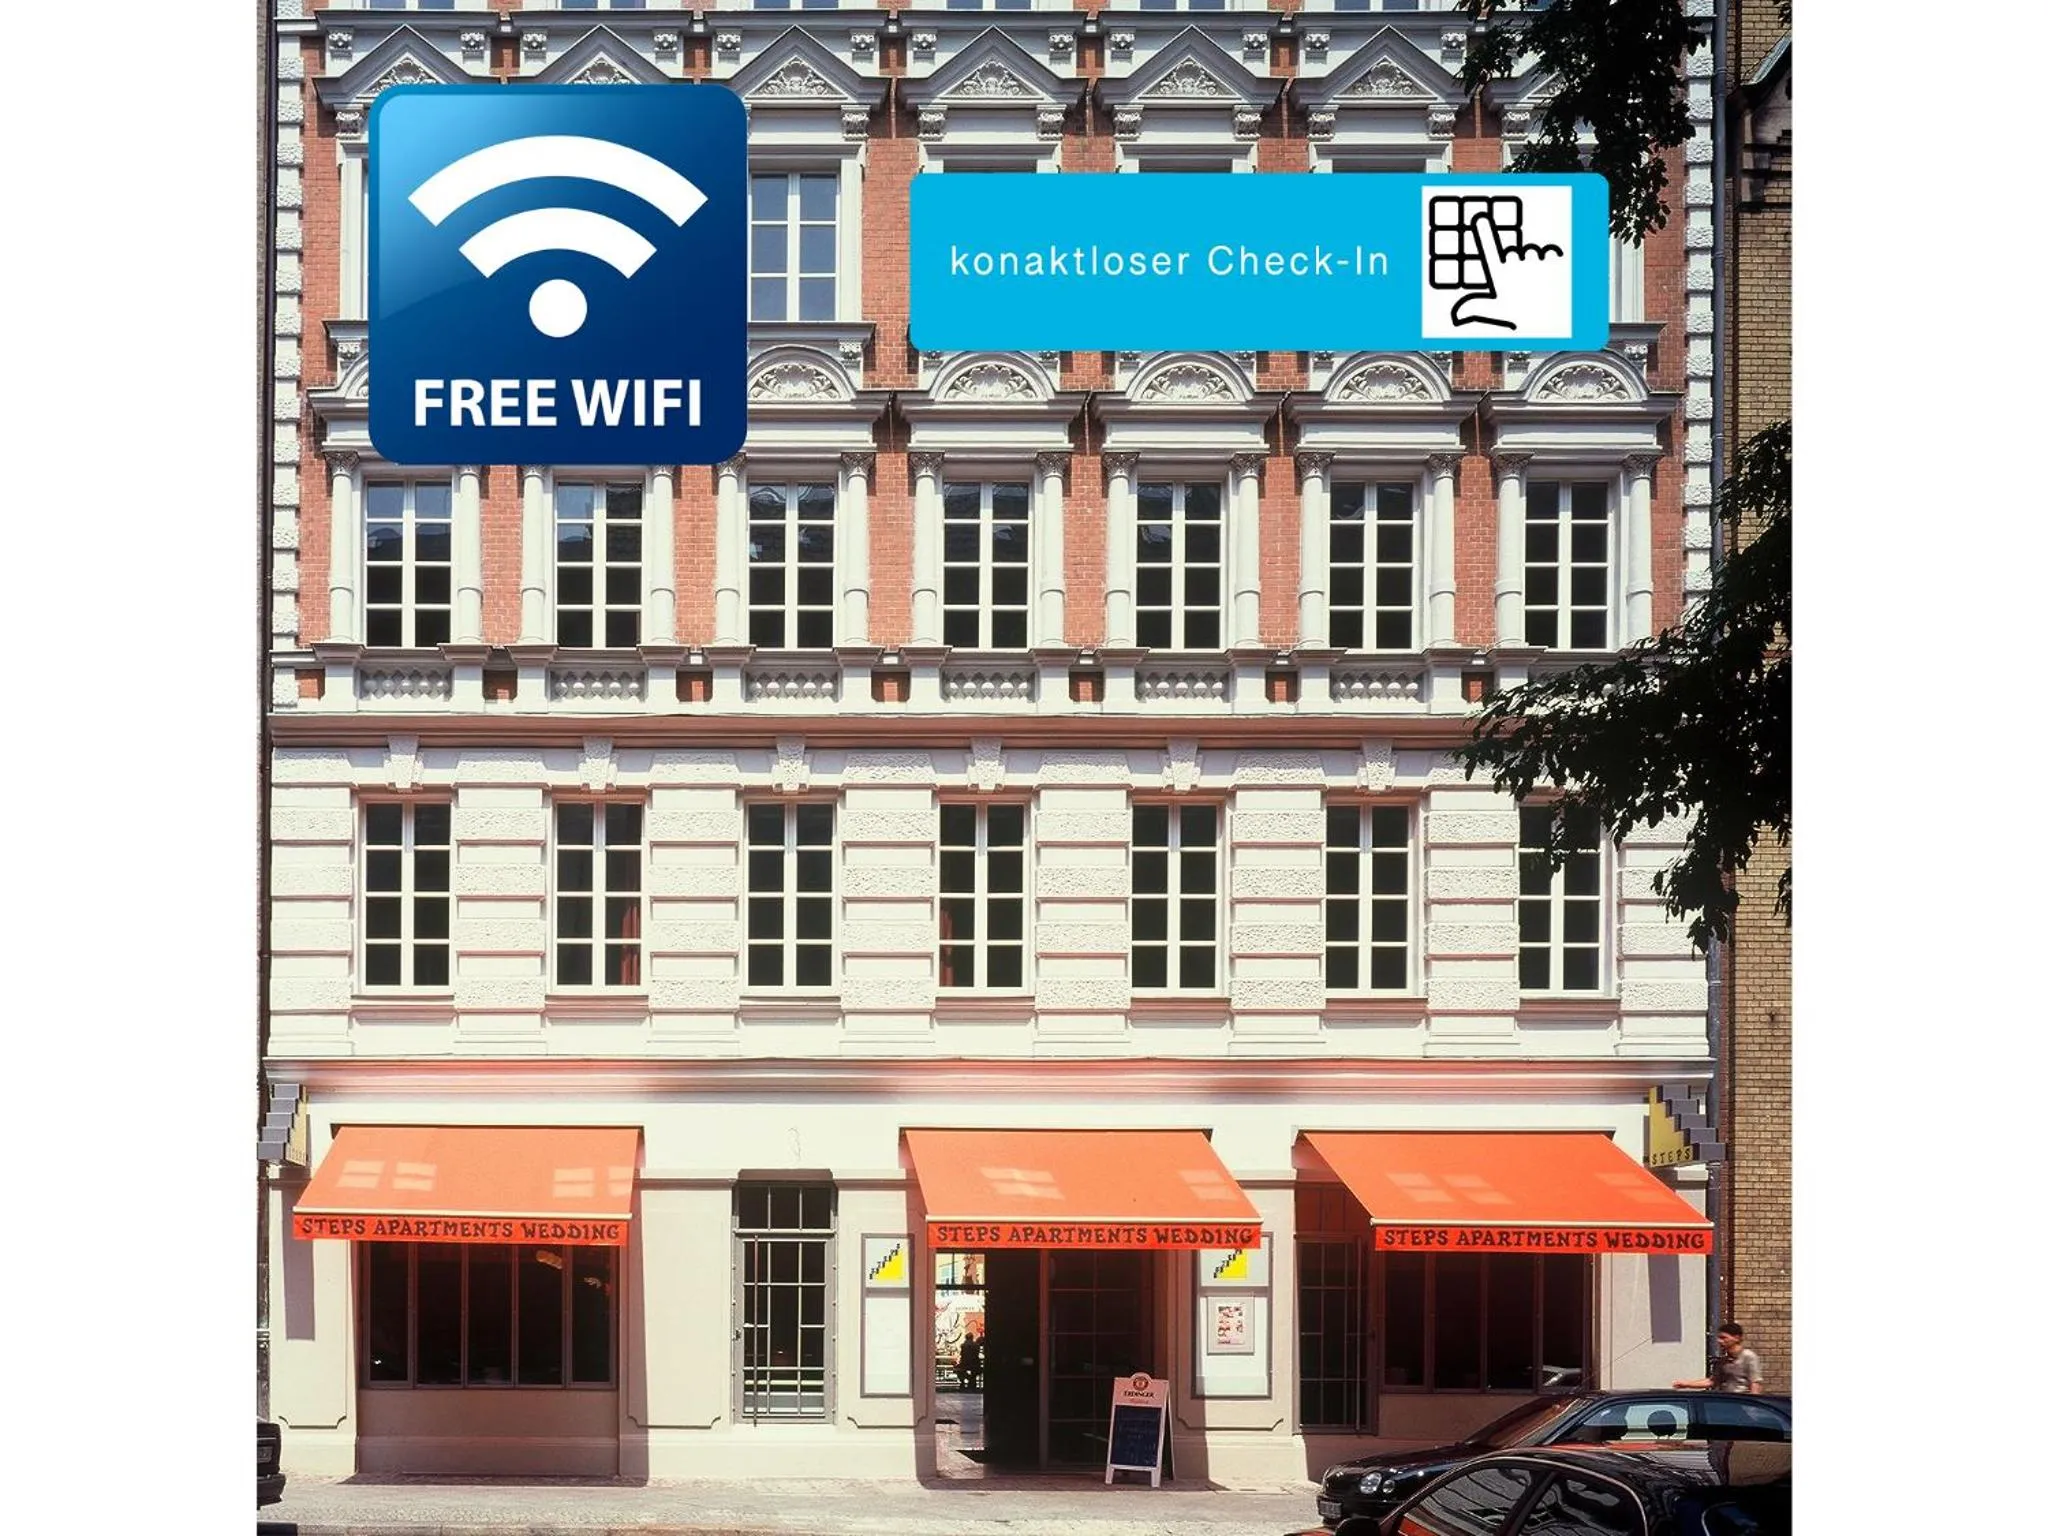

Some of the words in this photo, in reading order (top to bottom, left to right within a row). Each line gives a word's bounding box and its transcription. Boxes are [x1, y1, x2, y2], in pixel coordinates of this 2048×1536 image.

[1651, 1148, 1691, 1165] STEPS
[301, 1217, 366, 1235] STEPS
[372, 1219, 514, 1238] APARTMENTS
[520, 1221, 620, 1241] WEDDING
[937, 1225, 1001, 1242] STEPS
[1007, 1226, 1148, 1244] APARTMENTS
[1152, 1227, 1253, 1245] WEDDING
[1383, 1229, 1449, 1246] STEPS
[1455, 1229, 1598, 1248] APARTMENTS
[1603, 1230, 1706, 1250] WEDDING
